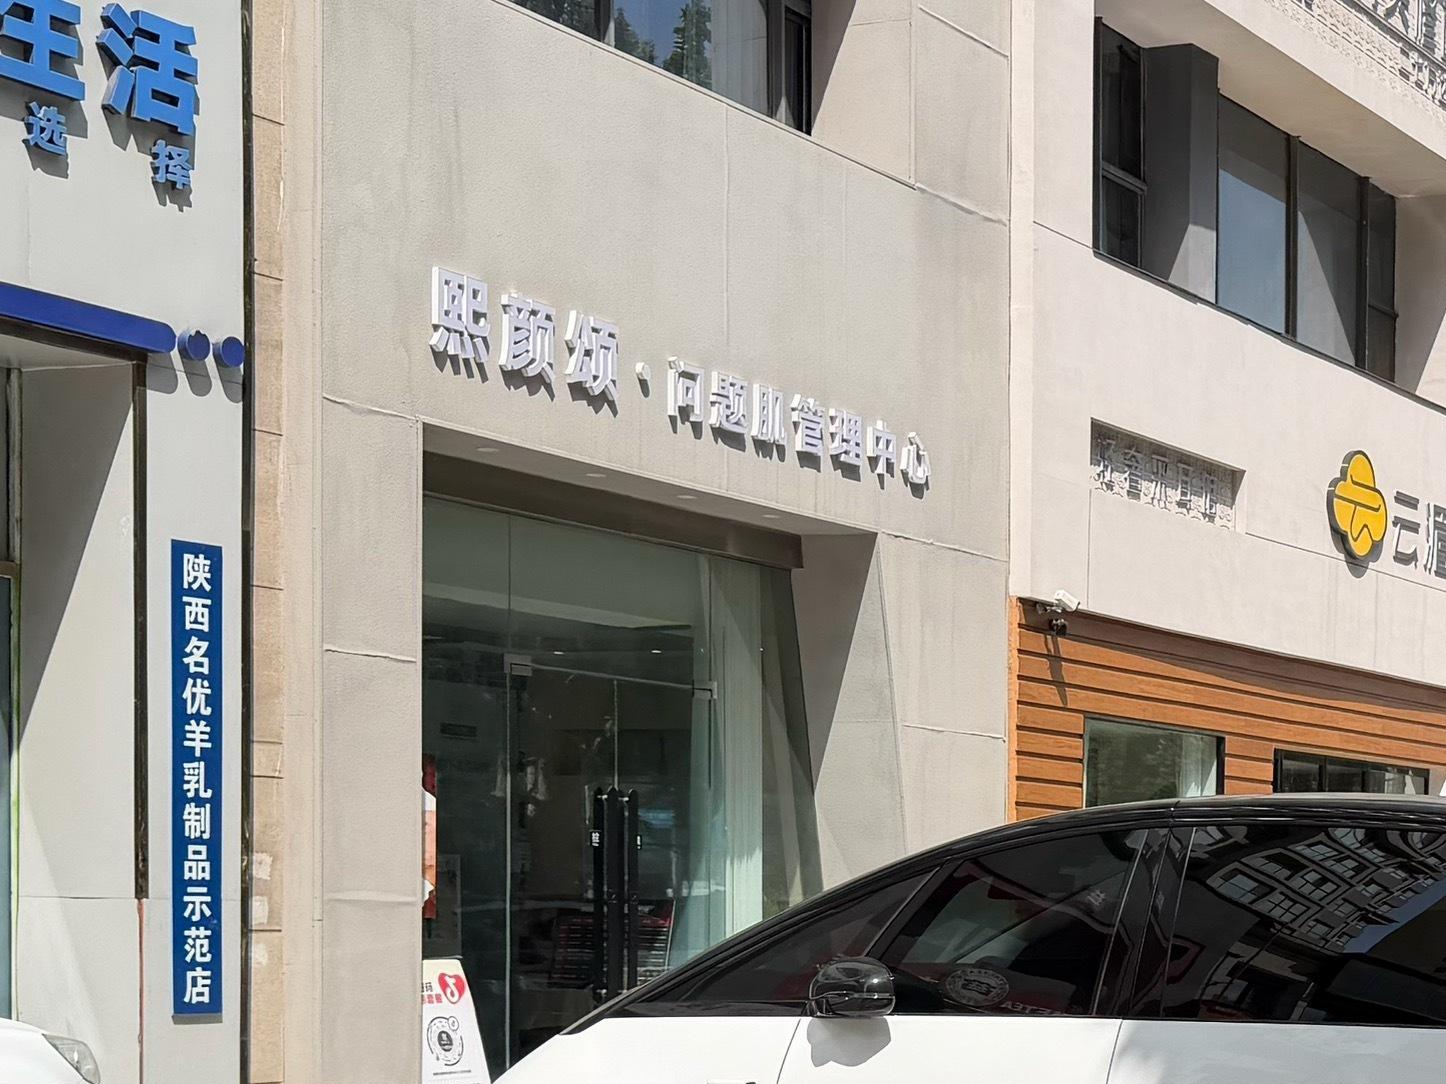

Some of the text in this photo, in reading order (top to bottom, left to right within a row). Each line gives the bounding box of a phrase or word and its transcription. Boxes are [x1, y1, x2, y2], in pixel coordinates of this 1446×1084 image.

[182, 553, 213, 1005] 陕西名优羊乳制品示范店
